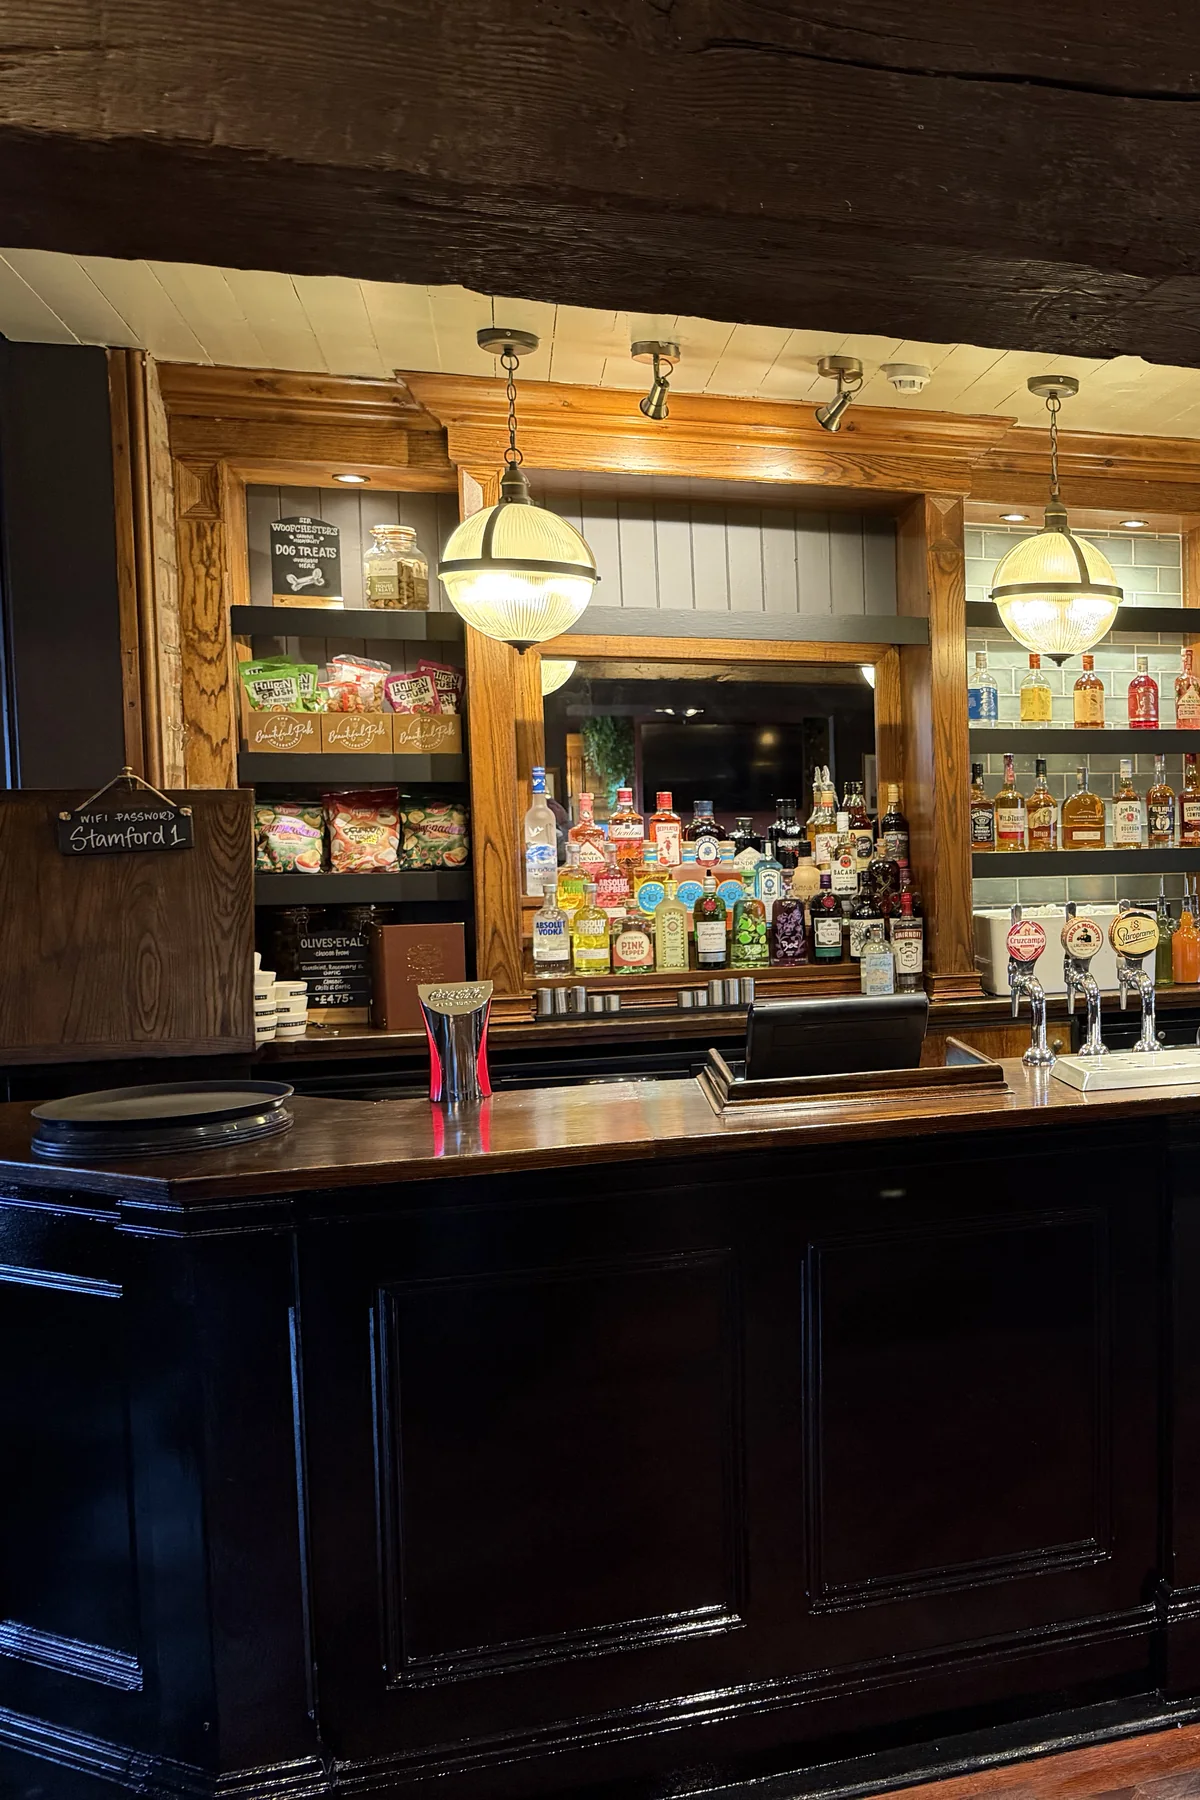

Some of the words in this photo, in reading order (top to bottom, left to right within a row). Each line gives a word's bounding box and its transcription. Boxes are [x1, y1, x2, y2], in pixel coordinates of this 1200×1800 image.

[275, 544, 296, 556] DOG
[300, 546, 337, 558] TREATS
[262, 689, 293, 700] CRUSH
[400, 688, 430, 700] CRUSH
[1119, 807, 1129, 816] JIM
[80, 814, 108, 823] WIFI
[115, 810, 175, 822] PASSWORD
[600, 878, 628, 886] ABSOLUT
[536, 921, 565, 929] ABSOLUT
[539, 928, 563, 936] VODKA
[894, 930, 922, 939] SMIRNOFF
[1081, 923, 1101, 942] MORETTI
[621, 941, 644, 950] PINK
[1010, 937, 1044, 945] Cruzcampo
